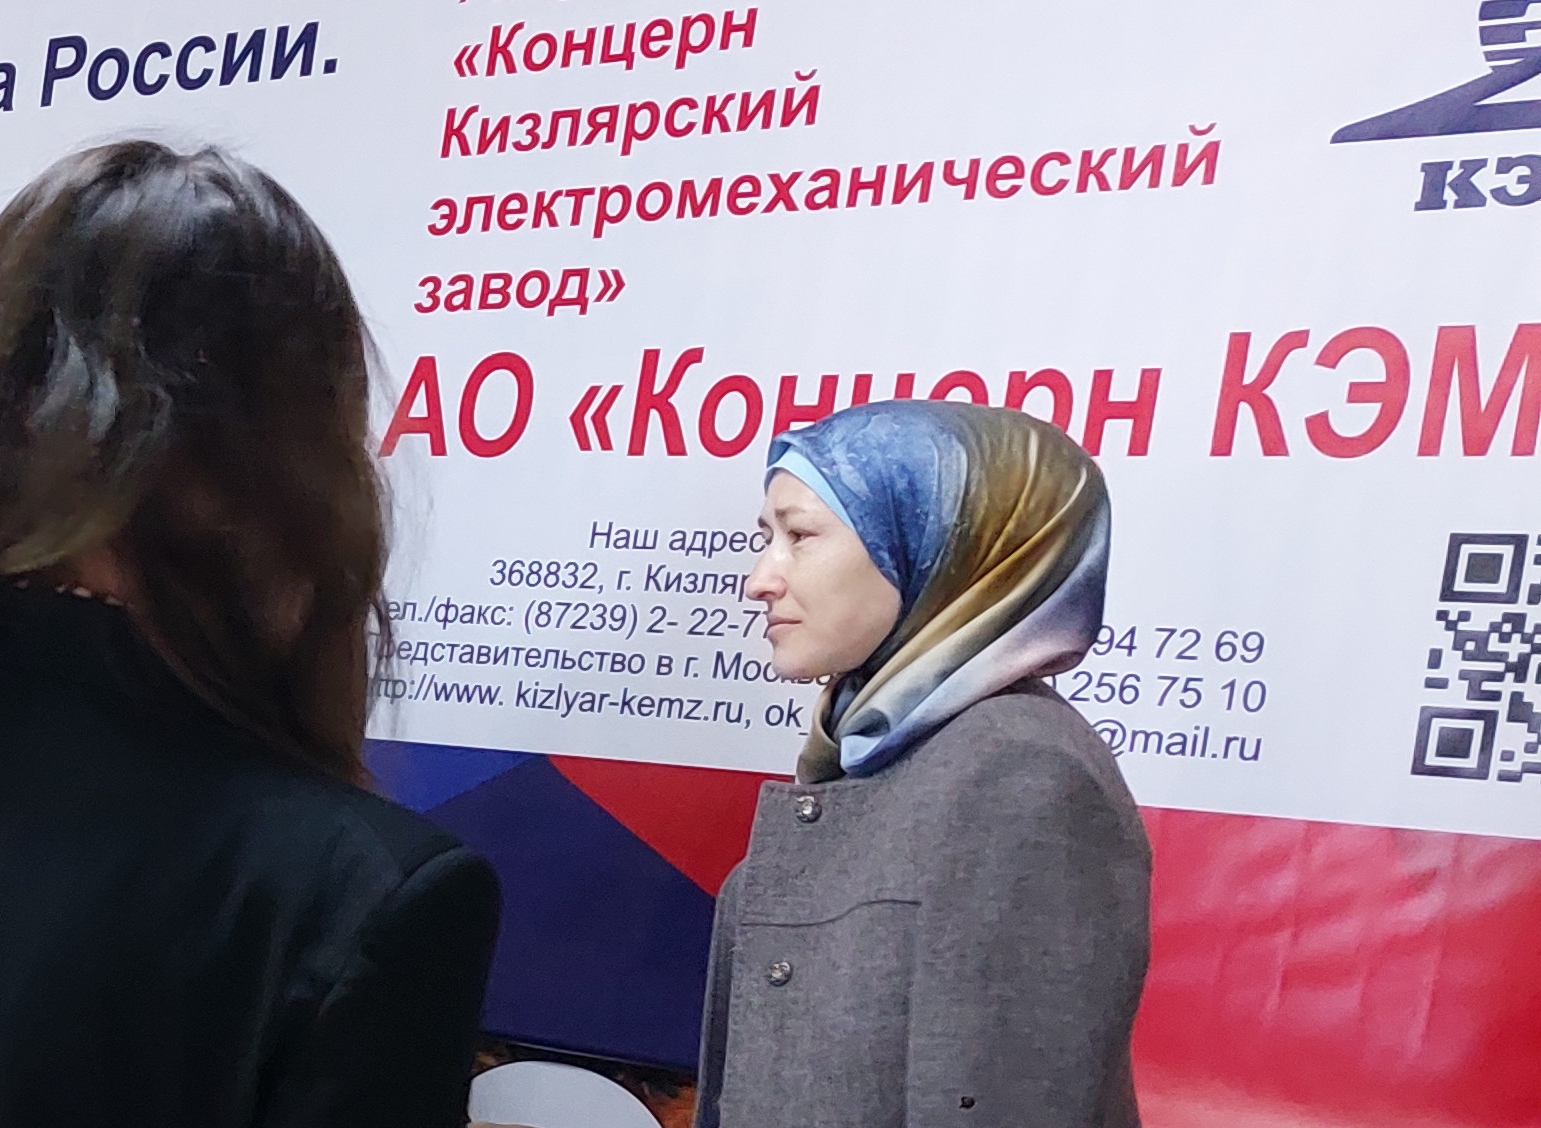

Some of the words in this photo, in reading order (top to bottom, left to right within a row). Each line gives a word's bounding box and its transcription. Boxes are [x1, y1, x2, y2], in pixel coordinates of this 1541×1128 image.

[40, 21, 338, 108] России.
[453, 7, 758, 78] «Концерн
[440, 69, 821, 158] Кизлярский
[427, 122, 1222, 239] электромеханический
[413, 268, 626, 317] завод»
[378, 350, 534, 459] АО
[589, 521, 659, 550] Наш
[489, 559, 604, 593] 368832,
[616, 569, 632, 591] г.
[385, 595, 515, 630] ел./факс:
[524, 599, 638, 640] (87239)
[1154, 627, 1201, 661] 72
[1214, 630, 1265, 664] 69
[382, 639, 646, 675] едставительство
[656, 654, 674, 676] в
[683, 656, 700, 678] г.
[712, 650, 832, 686] Мос
[1068, 671, 1141, 705] 256
[1156, 675, 1204, 709] 75
[1220, 678, 1267, 713] 10
[515, 680, 752, 729] kizlyar-kemz.ru,
[764, 698, 809, 735] ok_
[1092, 718, 1262, 762] @mail.ru
